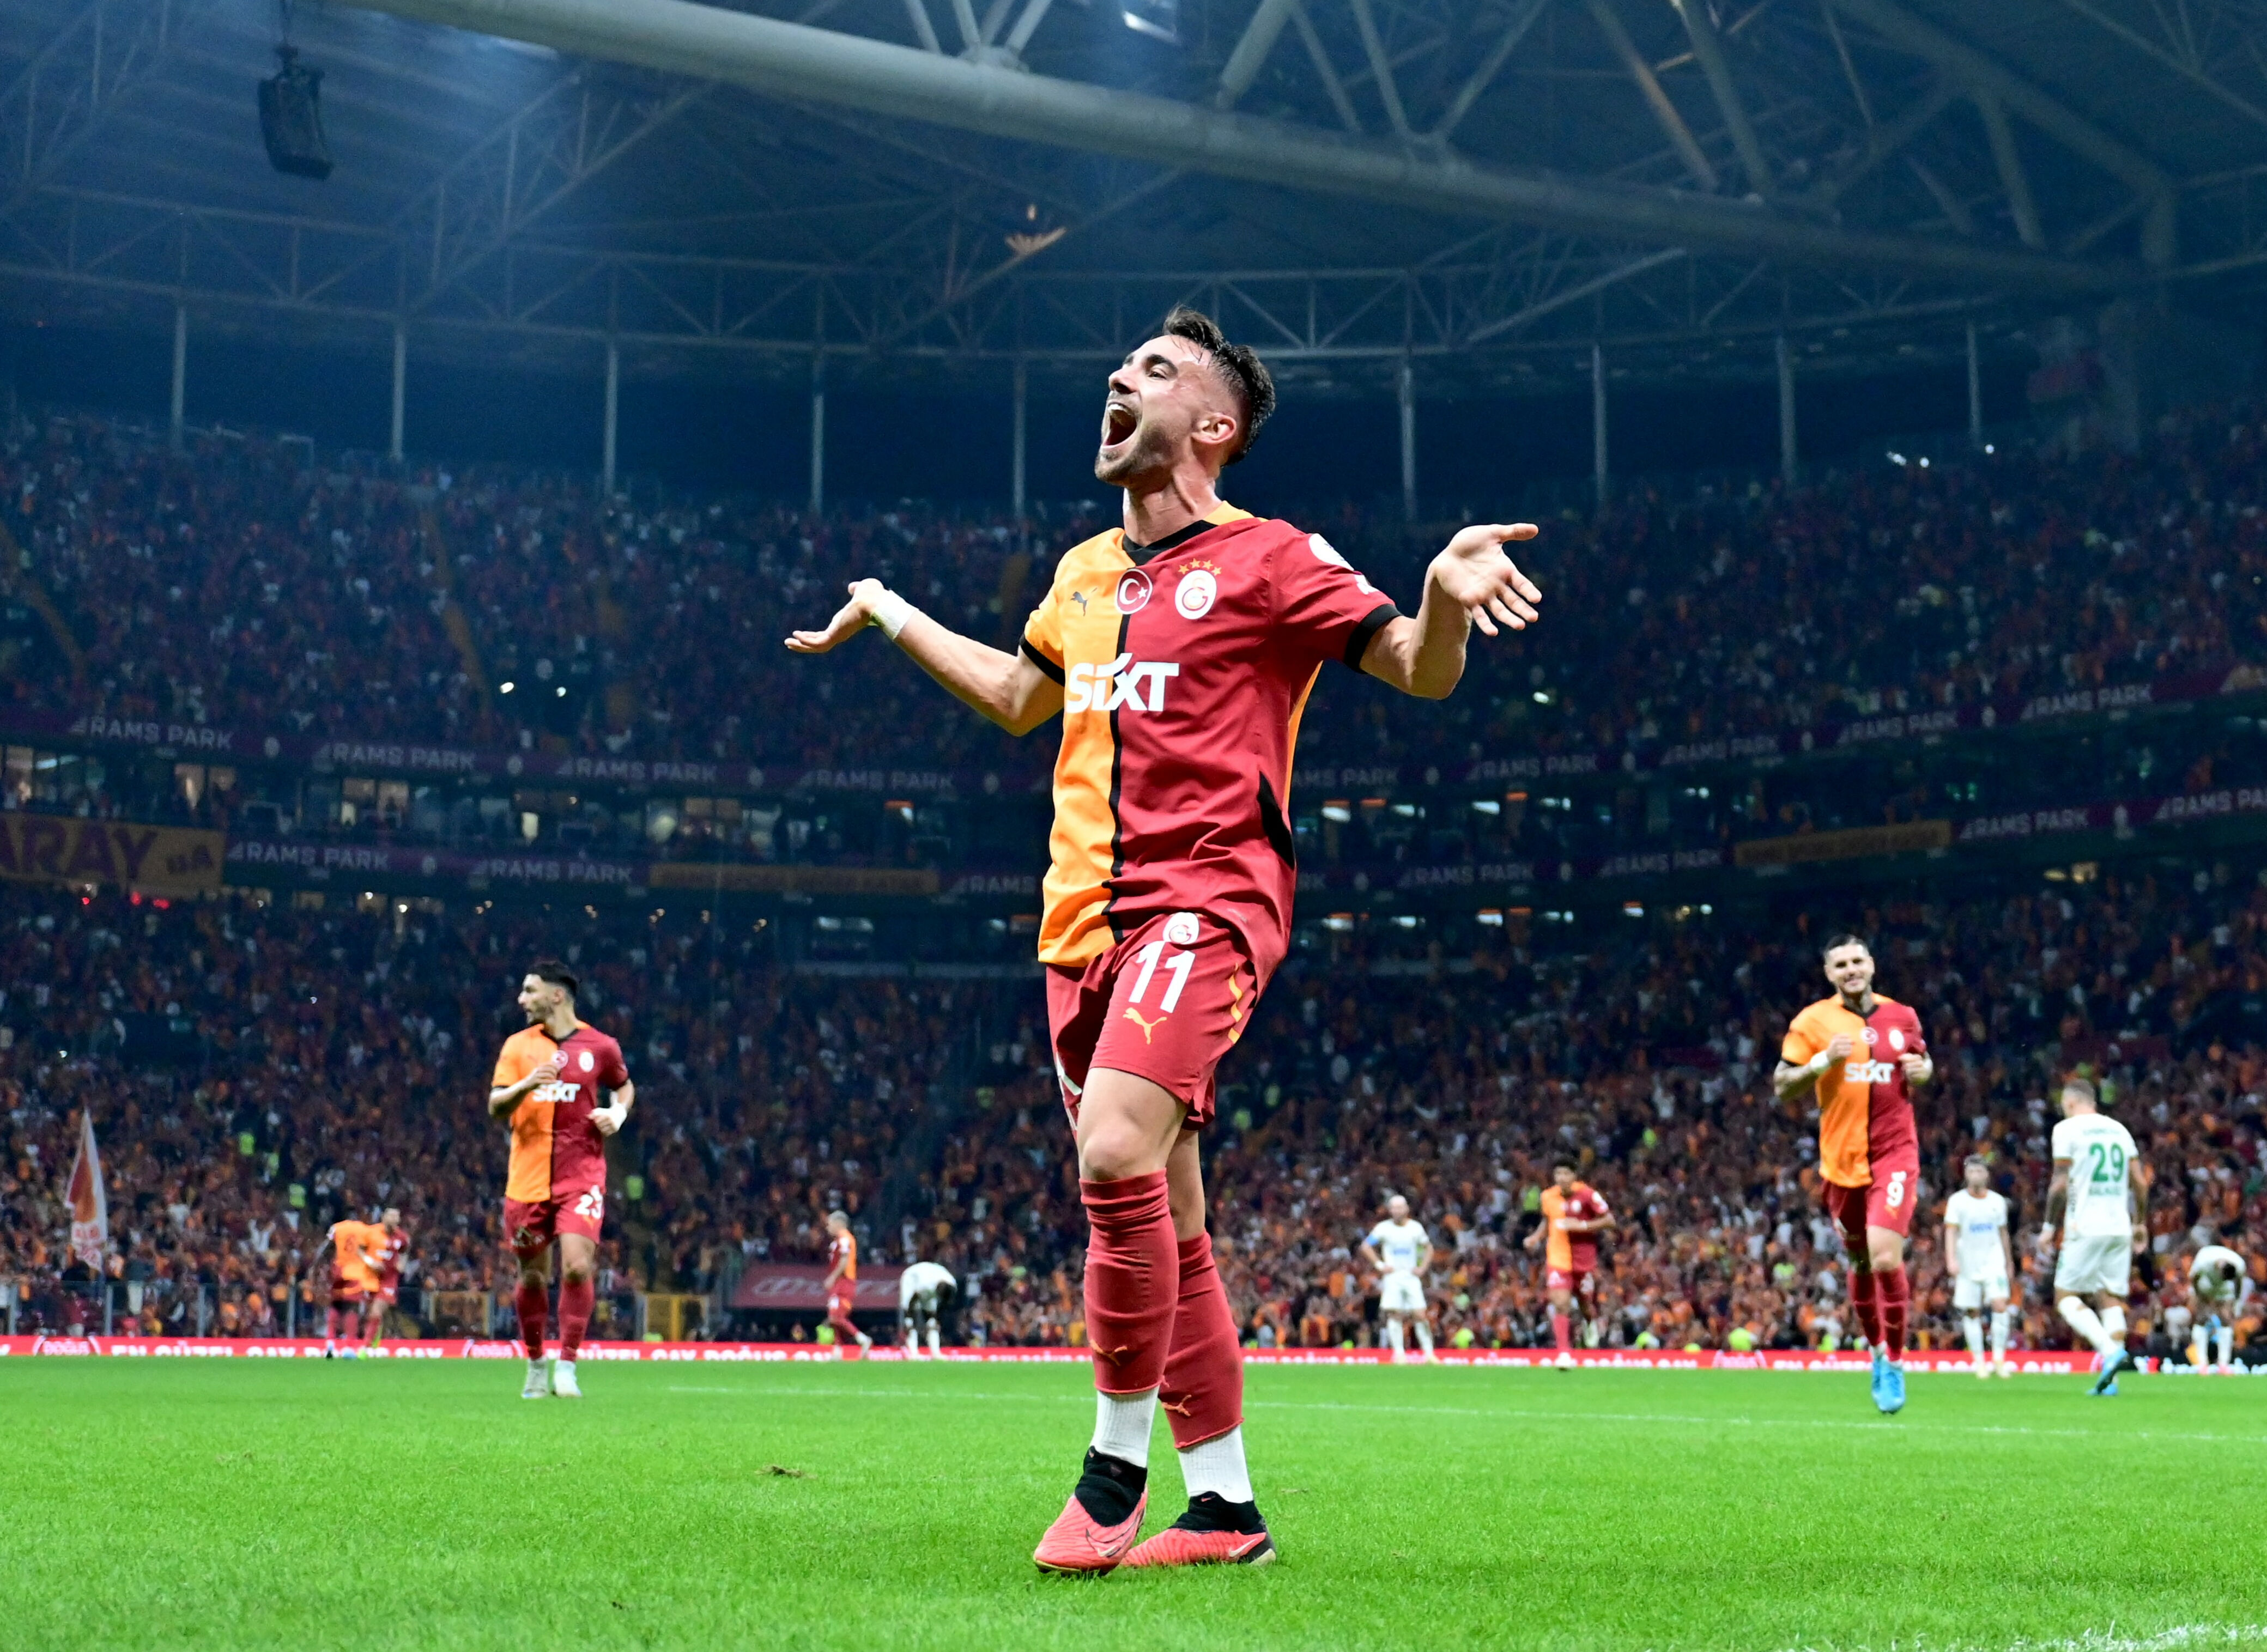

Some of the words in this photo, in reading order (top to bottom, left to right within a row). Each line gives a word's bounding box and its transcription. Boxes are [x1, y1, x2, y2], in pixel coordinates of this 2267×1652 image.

[1065, 653, 1180, 714] SIXT
[2035, 690, 2093, 714] RAMS
[2098, 683, 2152, 706] PARK
[90, 715, 160, 744] RAMS
[167, 724, 234, 751] PARK
[1852, 717, 1904, 738] RAMS
[1908, 710, 1959, 731] PARK
[333, 742, 404, 768] RAMS
[411, 747, 475, 771] PARK
[576, 757, 646, 781] RAMS
[653, 761, 718, 784] PARK
[818, 768, 884, 789] RAMS
[891, 770, 955, 791] PARK
[2172, 791, 2232, 816] RAMS
[2238, 787, 2267, 810] PA
[1974, 813, 2031, 837] RAMS
[2035, 807, 2089, 829] PARK
[246, 841, 317, 866] RAMS
[324, 846, 390, 871] PARK
[492, 860, 561, 882] RAMS
[568, 862, 634, 884] PARK
[1128, 940, 1196, 1013] 11
[1844, 1059, 1895, 1083] SIXT
[2089, 1142, 2124, 1182] 29
[1887, 1181, 1905, 1207] 9
